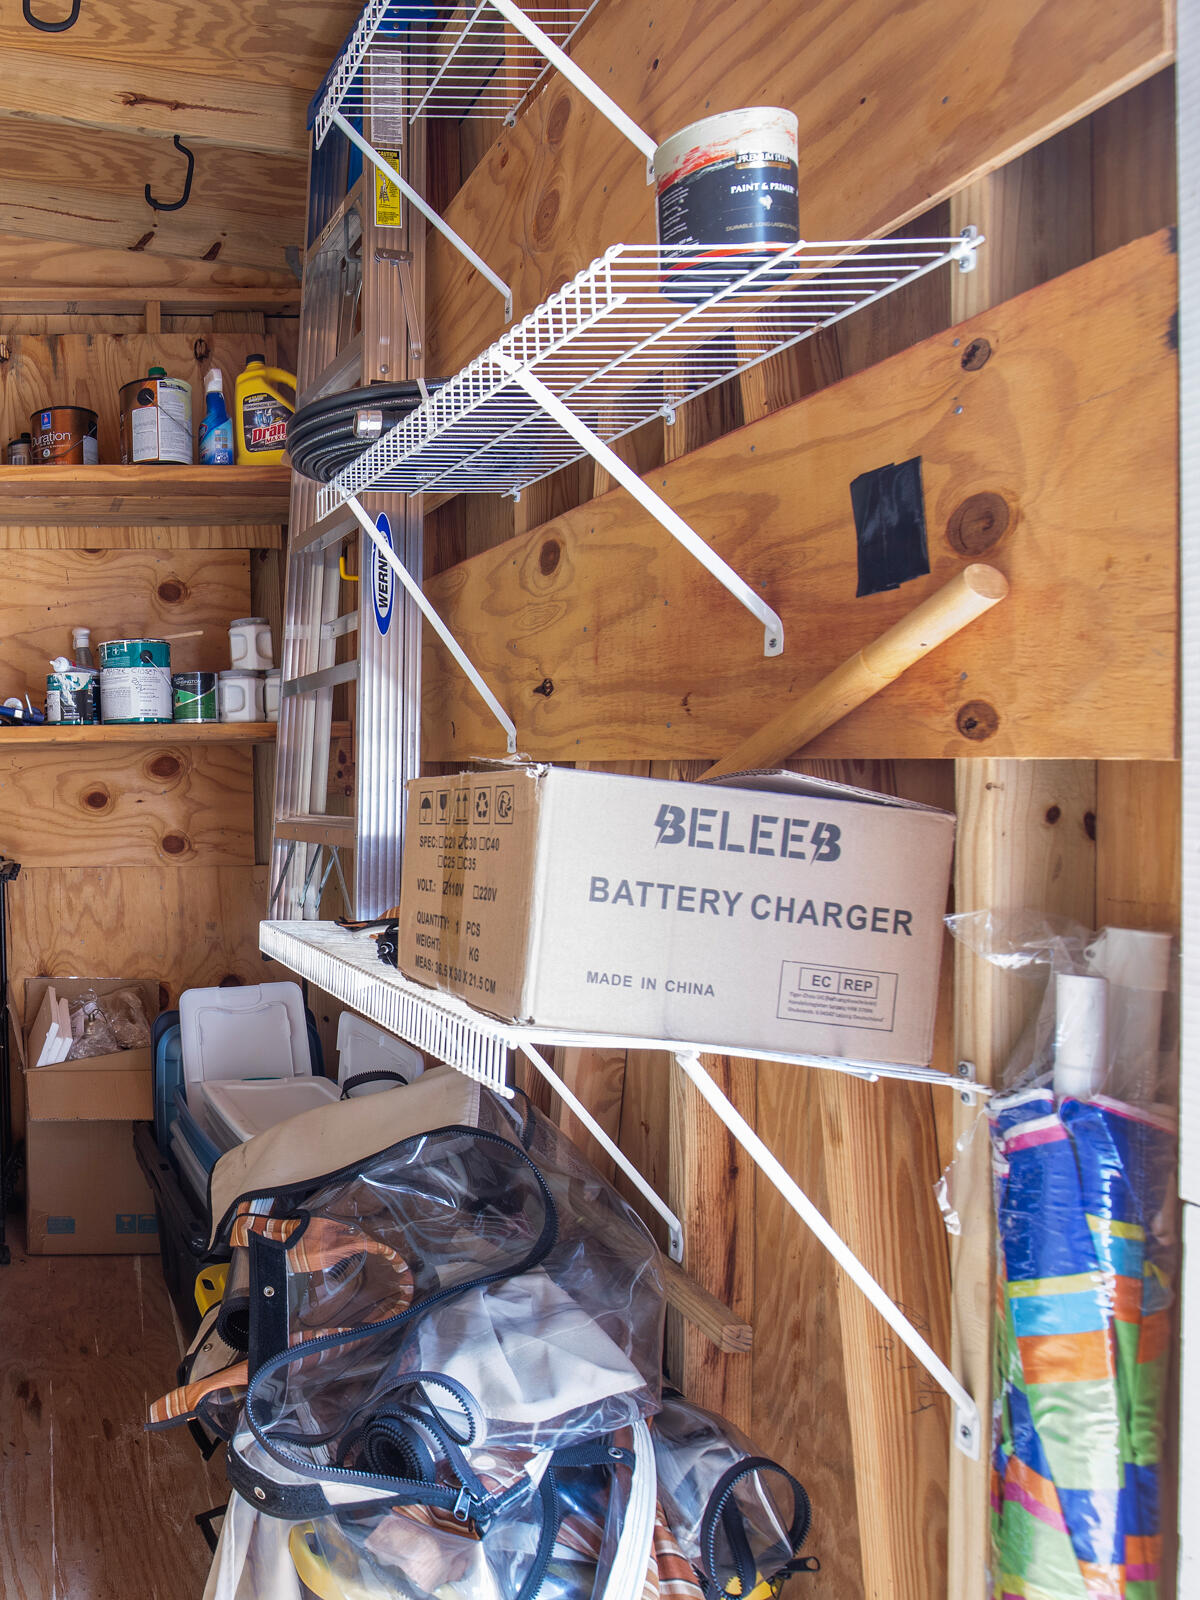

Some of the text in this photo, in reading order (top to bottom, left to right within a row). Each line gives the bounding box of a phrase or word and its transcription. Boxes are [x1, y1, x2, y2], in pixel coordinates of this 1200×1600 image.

[731, 182, 760, 194] PAINT
[761, 182, 769, 190] &
[378, 537, 388, 608] WERNE
[419, 835, 438, 849] SPEC:
[589, 876, 913, 936] BATTERY CHARGER
[416, 911, 450, 930] QUANTITY:
[466, 921, 481, 937] PCS
[415, 933, 480, 962] WEIGHT: KG
[415, 955, 434, 973] MEAS:
[469, 973, 484, 990] 21.5
[484, 978, 496, 994] CM
[586, 970, 715, 997] MADE IN CHINA
[811, 974, 832, 988] EC
[843, 978, 873, 992] REP
